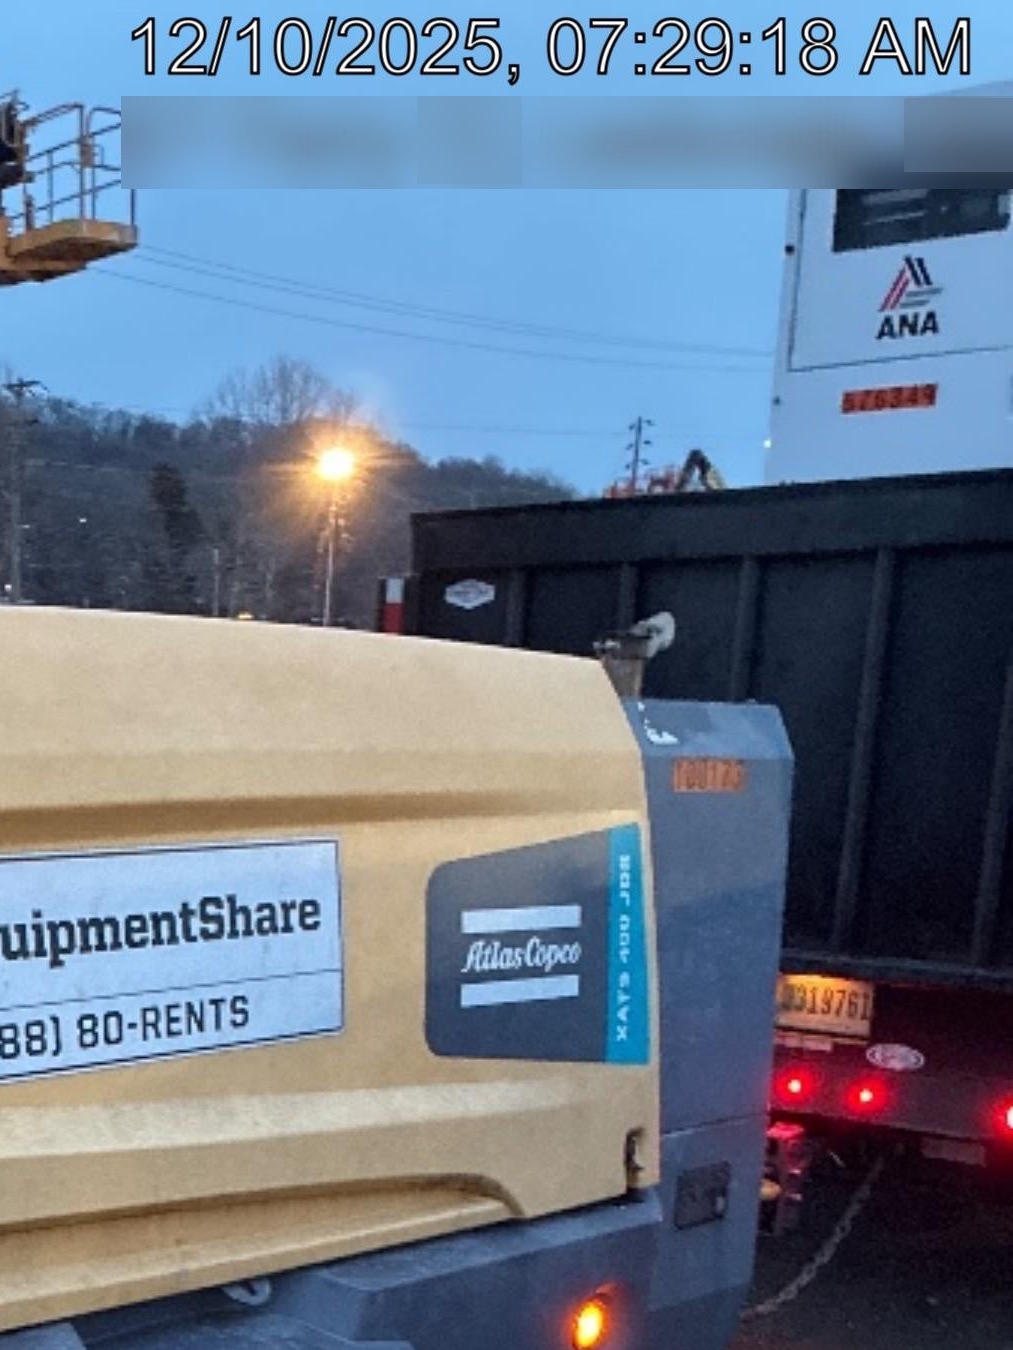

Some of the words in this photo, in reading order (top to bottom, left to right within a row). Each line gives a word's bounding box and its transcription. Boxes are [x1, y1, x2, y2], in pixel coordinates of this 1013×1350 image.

[876, 311, 940, 340] ANA
[460, 939, 522, 972] Atlas
[524, 936, 582, 972] Copco
[77, 995, 250, 1051] 80-RENTS
